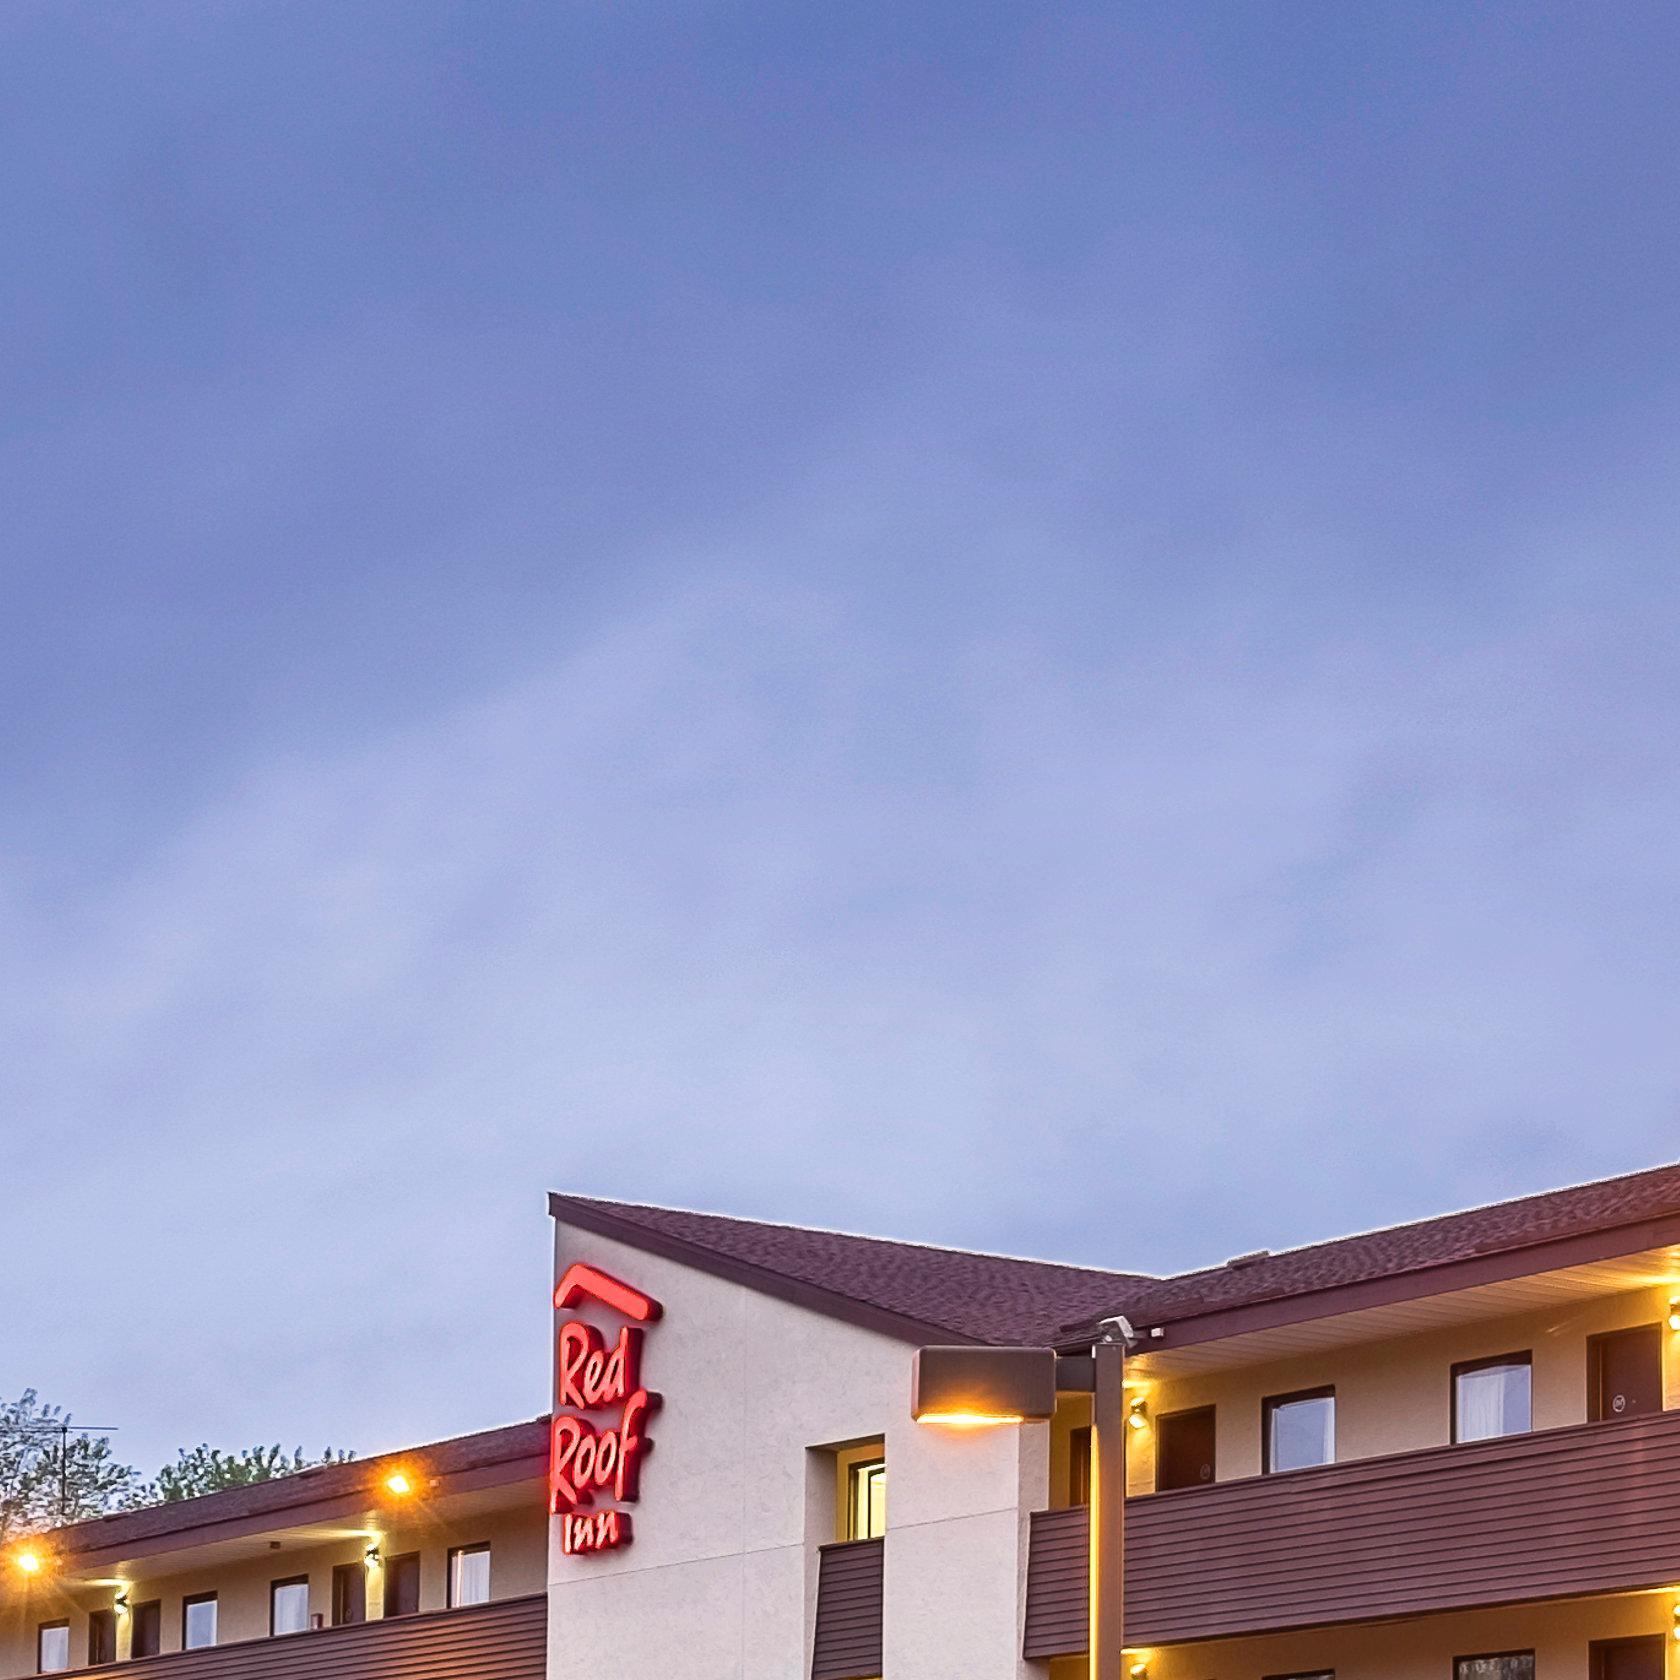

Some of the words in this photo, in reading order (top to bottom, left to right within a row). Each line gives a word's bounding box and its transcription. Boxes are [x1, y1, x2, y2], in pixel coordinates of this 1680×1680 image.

[559, 1321, 631, 1410] Red
[549, 1388, 649, 1513] Roof
[563, 1511, 622, 1555] Inn
